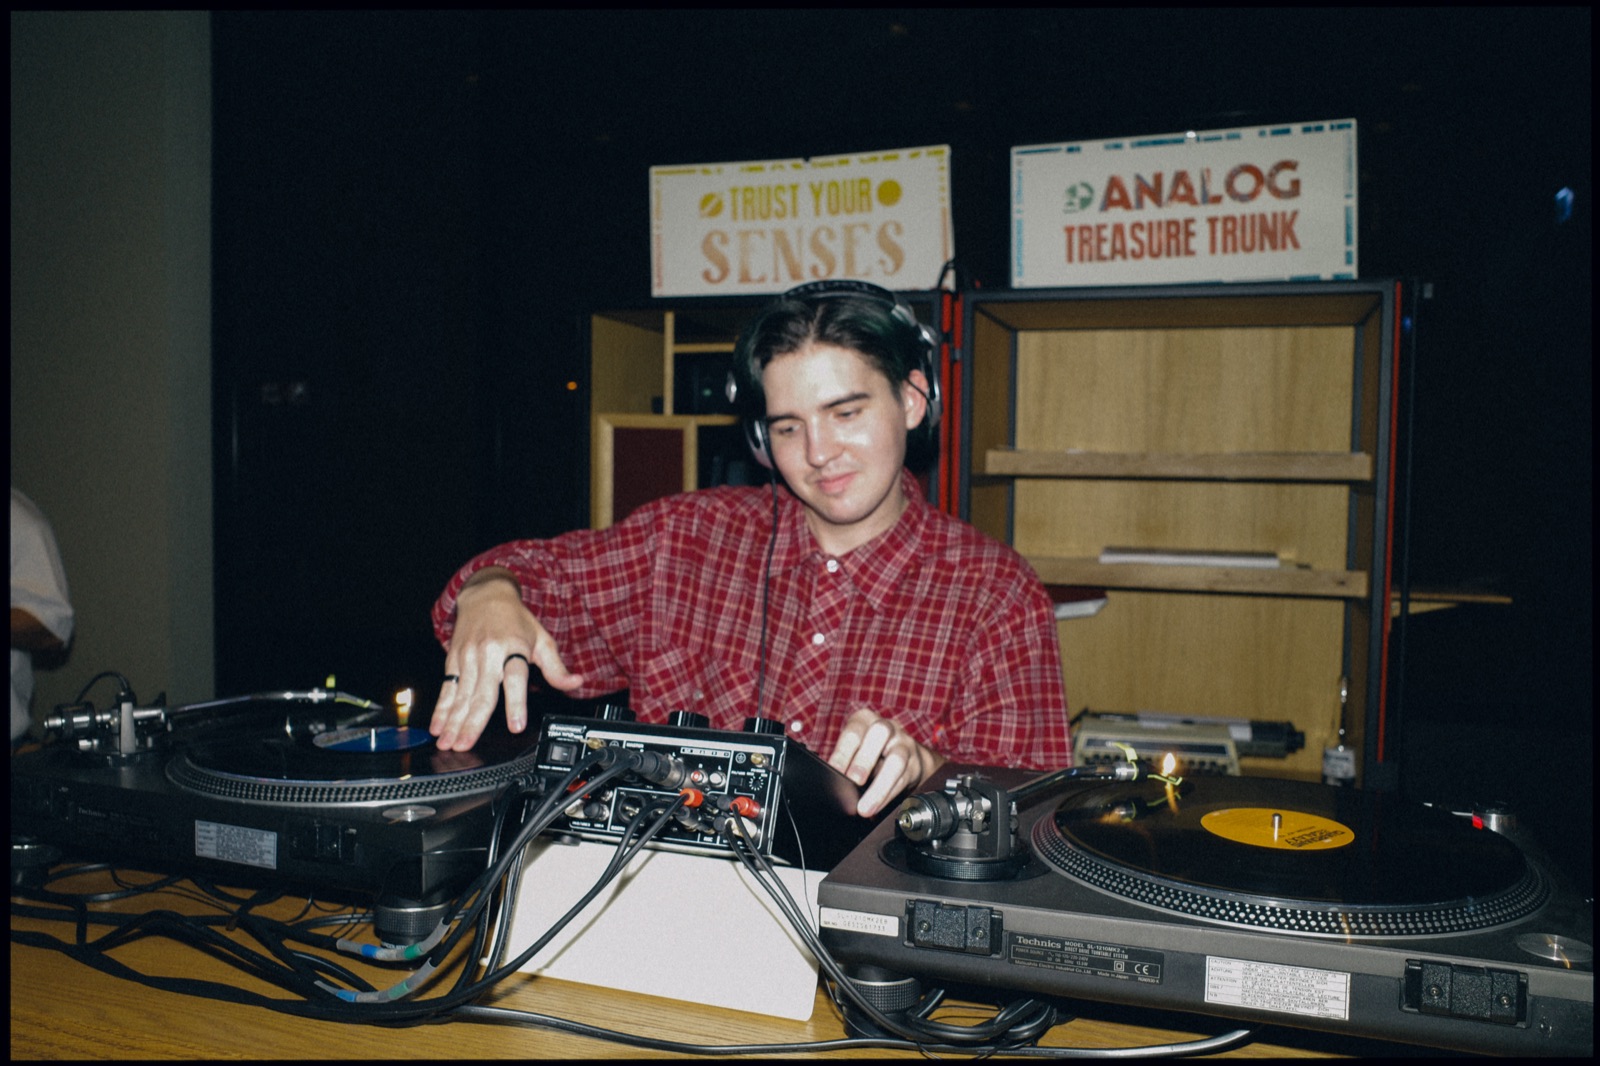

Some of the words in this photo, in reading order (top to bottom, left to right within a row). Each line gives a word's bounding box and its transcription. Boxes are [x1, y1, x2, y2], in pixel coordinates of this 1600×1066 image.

[728, 183, 799, 222] TRUST
[808, 177, 873, 218] YOUR
[1099, 159, 1301, 212] ANALOG
[701, 220, 905, 285] SENSES
[1064, 217, 1197, 264] TREASURE
[1206, 209, 1301, 255] TRUNK
[1016, 935, 1062, 949] Technics
